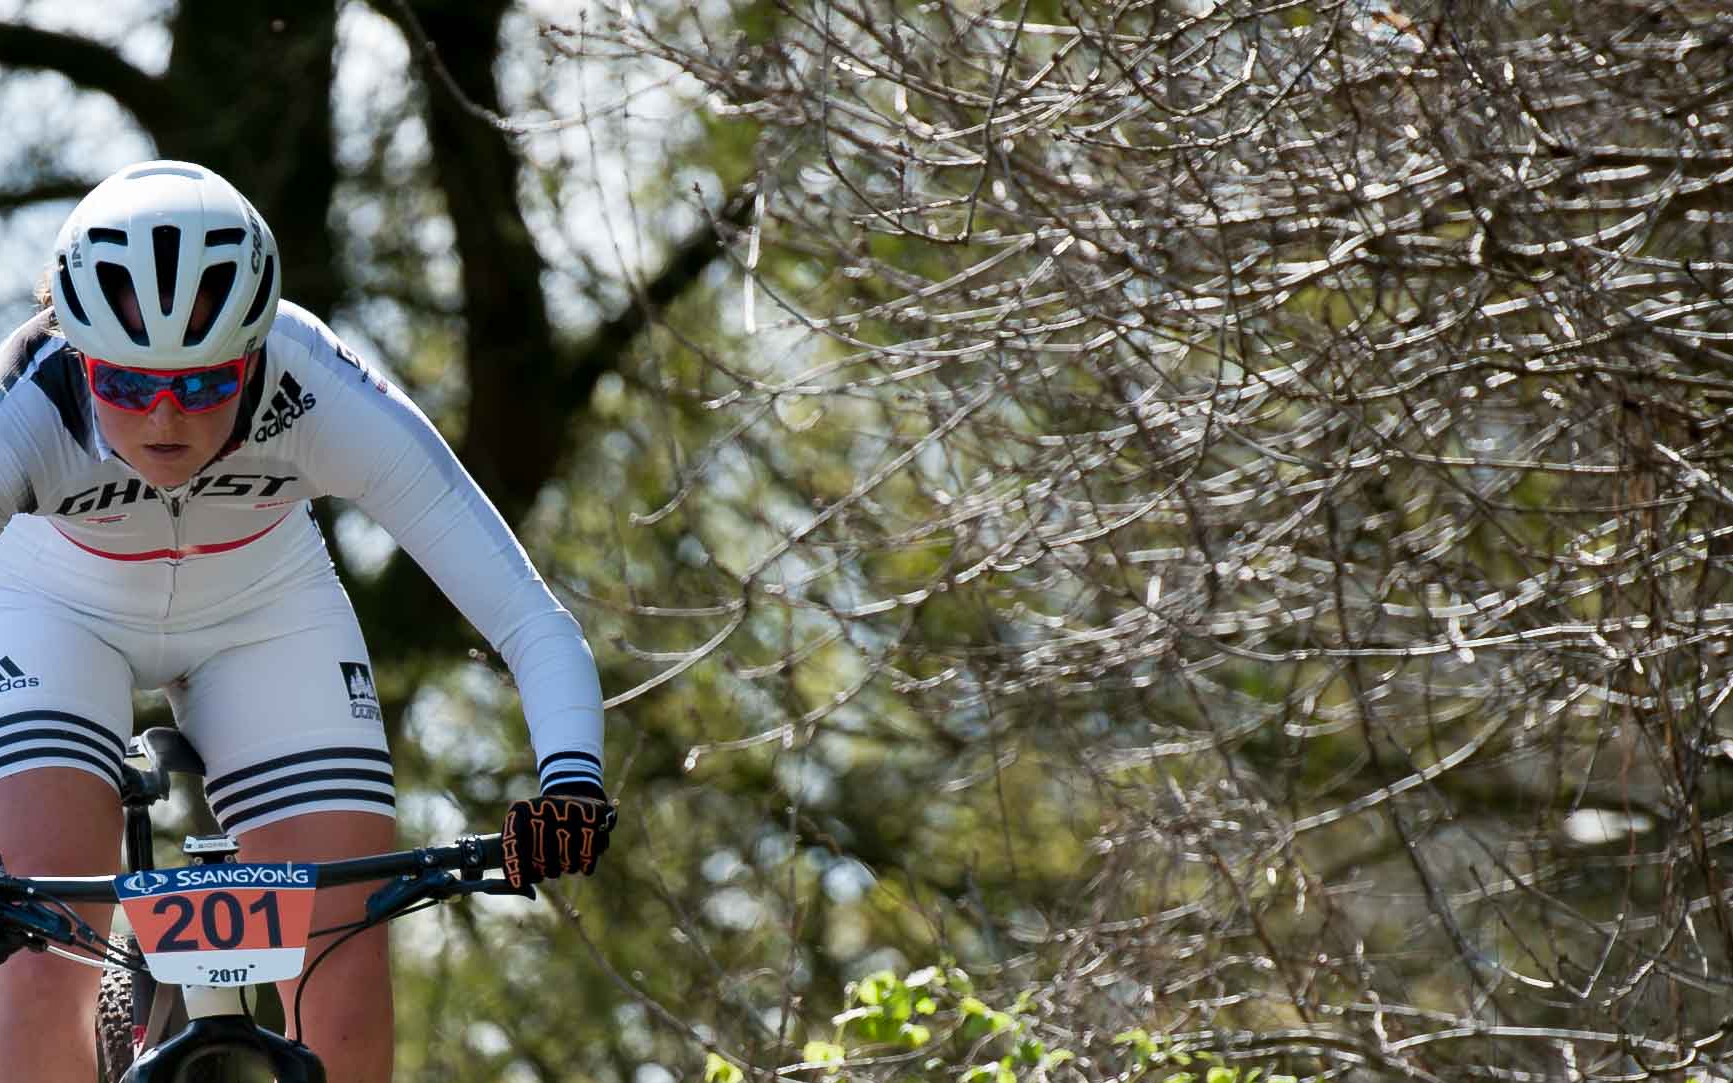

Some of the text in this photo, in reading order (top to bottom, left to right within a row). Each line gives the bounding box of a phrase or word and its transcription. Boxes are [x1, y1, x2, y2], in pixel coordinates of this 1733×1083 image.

[254, 392, 317, 443] adidas
[152, 890, 283, 952] 201
[208, 968, 248, 983] 2017
